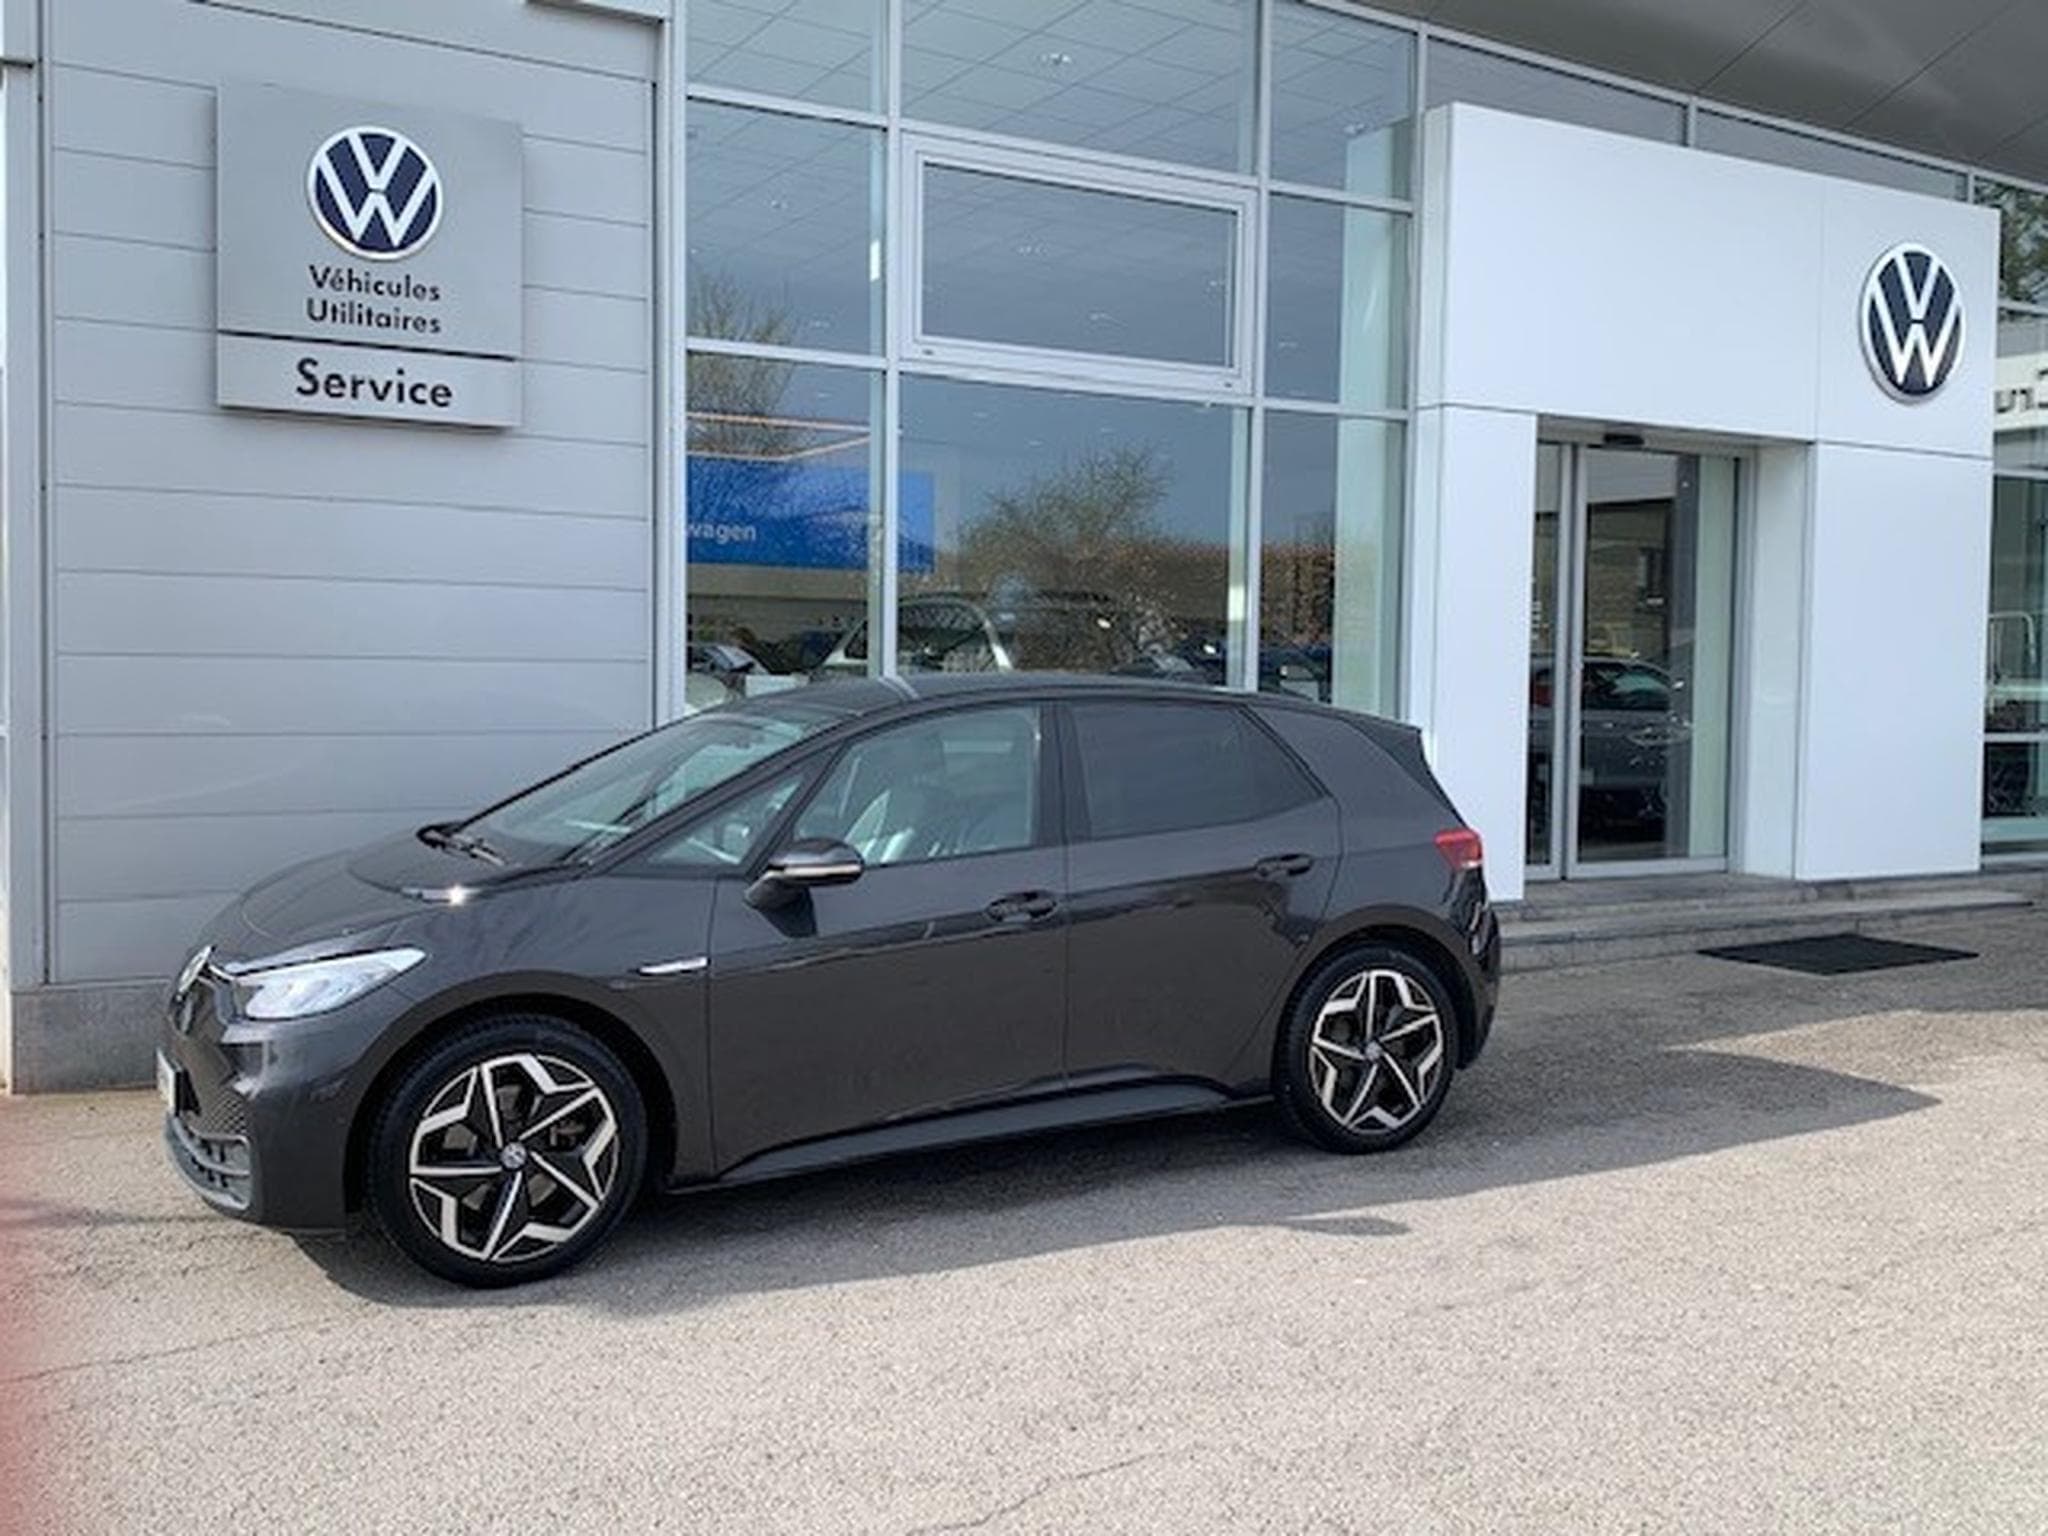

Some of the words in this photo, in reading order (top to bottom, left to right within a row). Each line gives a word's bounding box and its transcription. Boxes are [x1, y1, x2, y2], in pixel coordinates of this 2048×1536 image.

[310, 128, 441, 257] VW
[309, 265, 440, 300] Véhicules
[307, 299, 441, 333] Utilitaires
[1864, 245, 1964, 396] VW
[296, 358, 452, 407] Service
